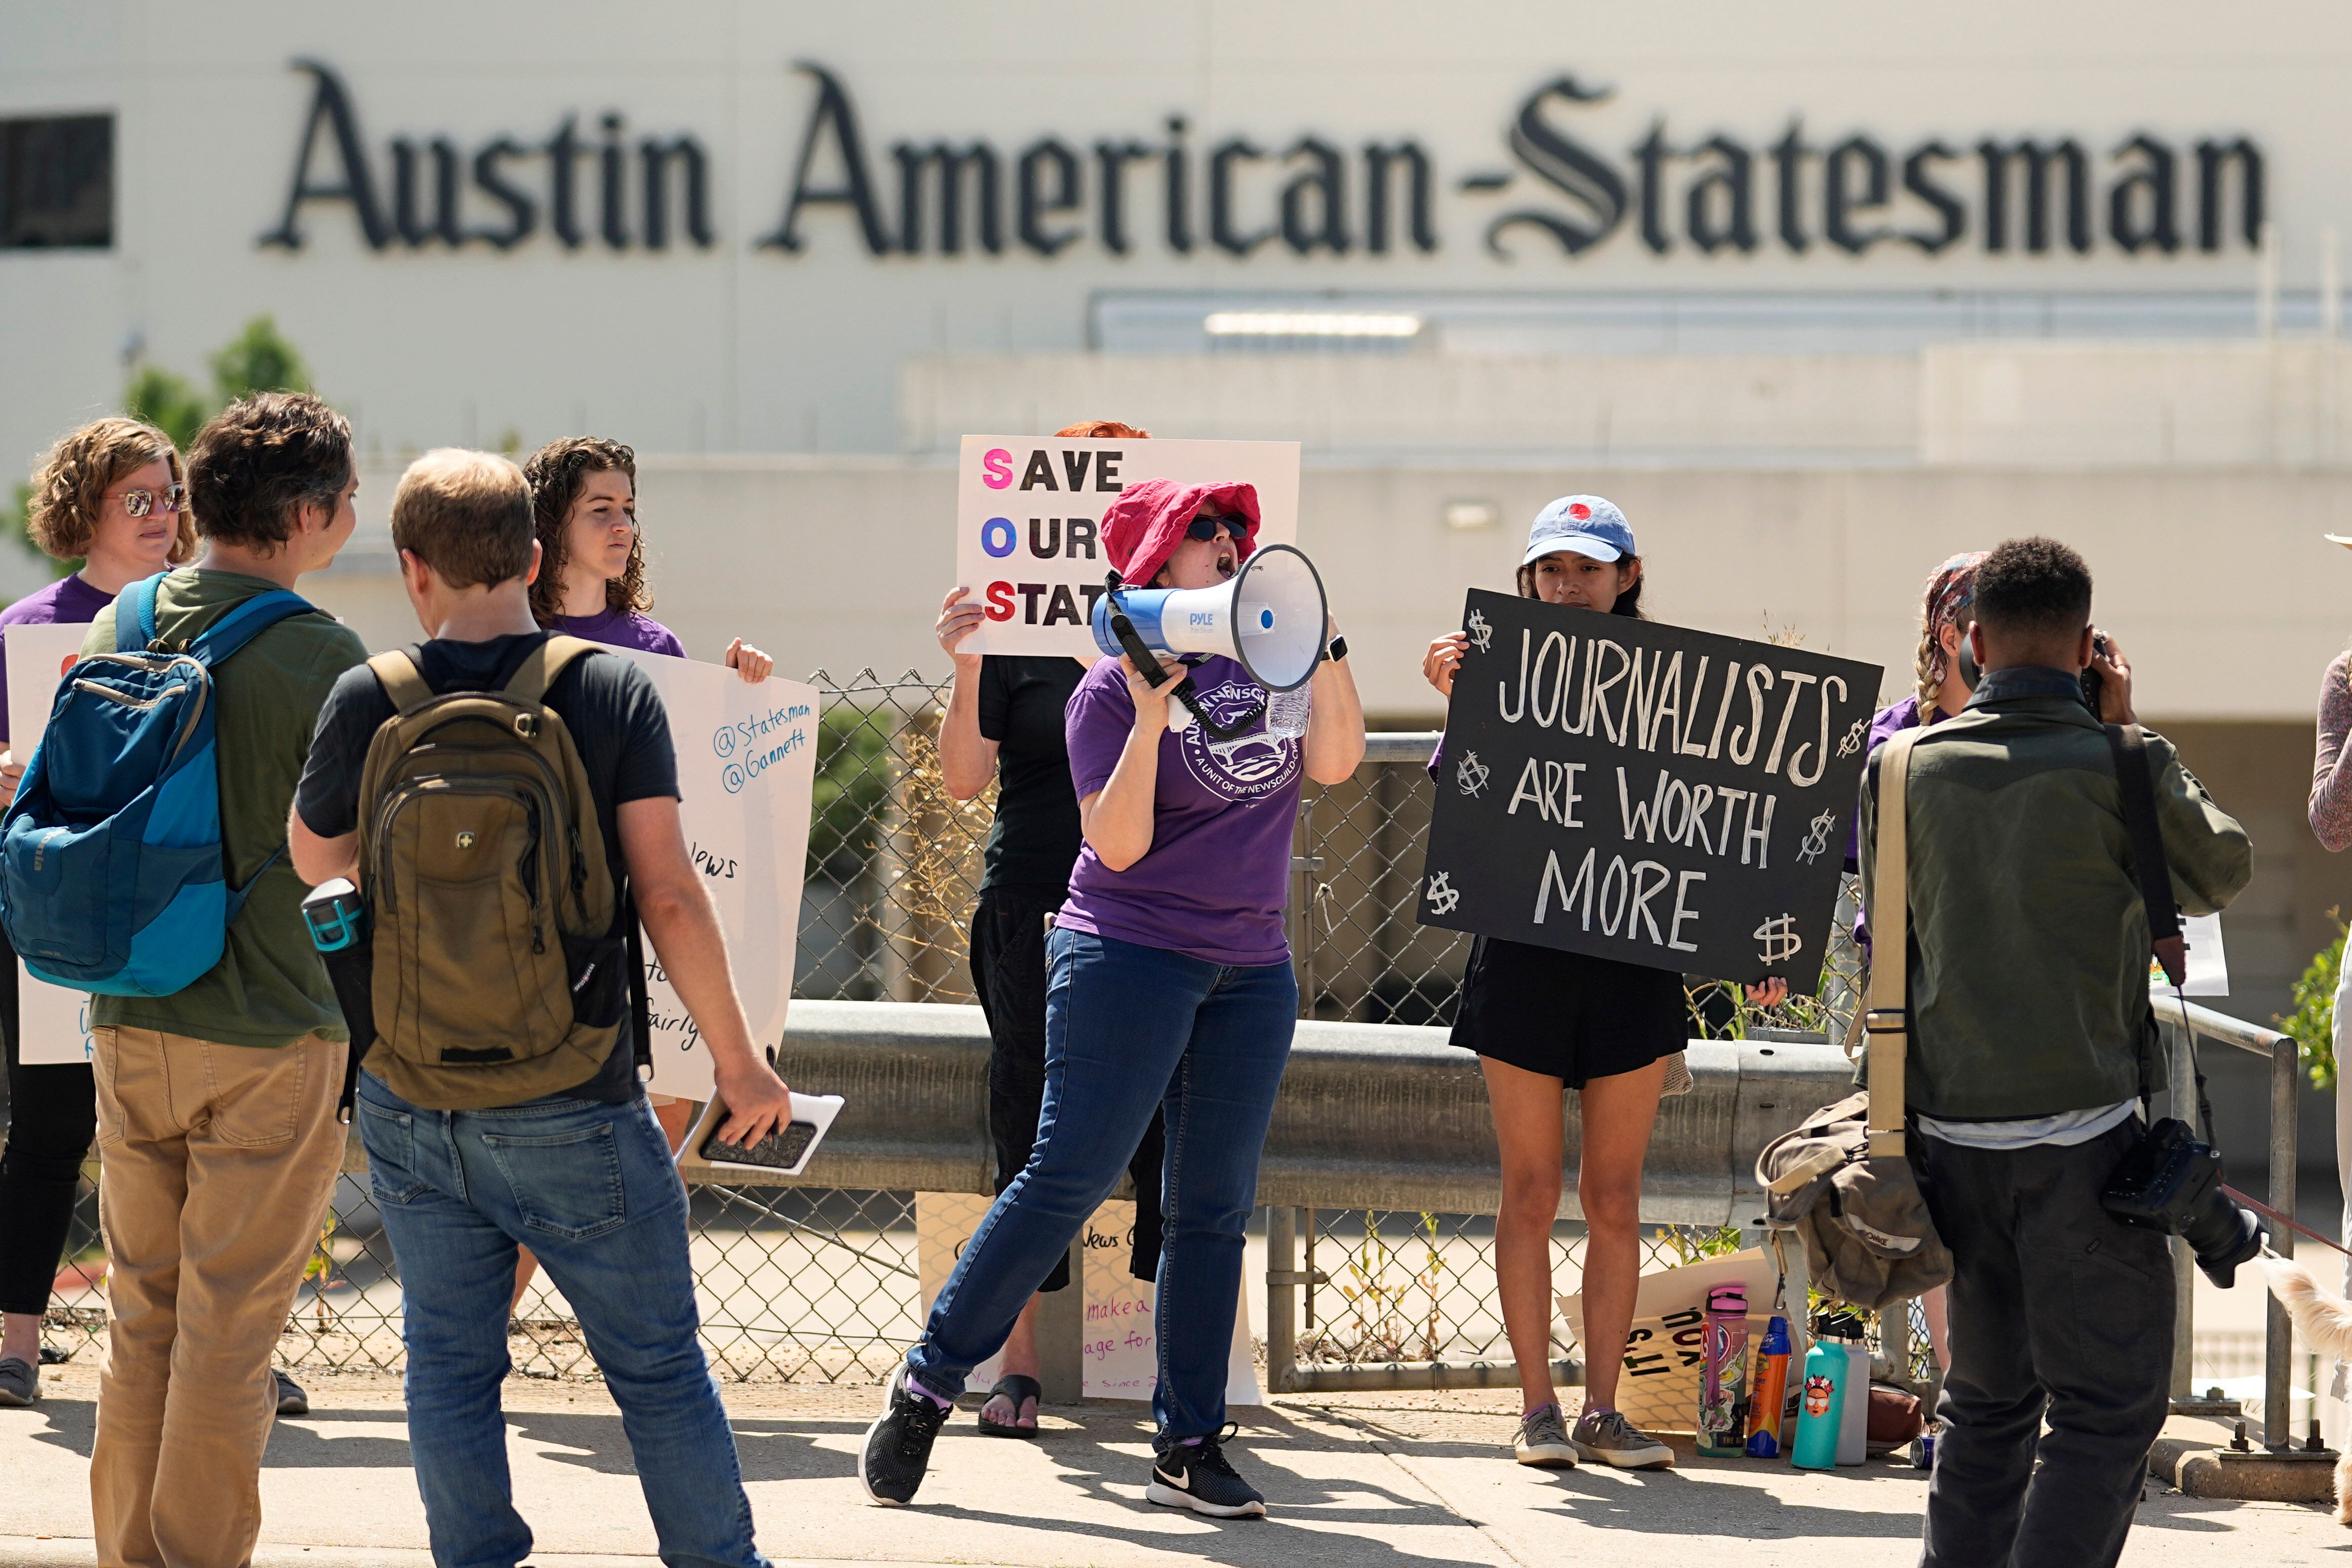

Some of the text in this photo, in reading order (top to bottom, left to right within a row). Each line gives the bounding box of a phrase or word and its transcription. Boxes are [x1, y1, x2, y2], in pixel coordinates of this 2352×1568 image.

[257, 60, 715, 254] Austin
[983, 448, 1123, 492] SAVE
[981, 517, 1097, 560] OUR
[985, 580, 1106, 626] STAT
[1190, 613, 1213, 625] PYLE
[1498, 628, 1847, 787] JOURNALISTS
[713, 704, 811, 758] @Statesman
[722, 728, 806, 794] @Gannett
[1196, 758, 1205, 766] A
[1202, 764, 1224, 784] UNIT
[1221, 781, 1235, 792] OF
[1234, 786, 1249, 794] THE
[1507, 757, 1777, 869] ARE WORTH
[1533, 847, 1707, 953] MORE
[1865, 1232, 1889, 1246] OMKE
[1088, 1296, 1151, 1321] make a
[1085, 1330, 1152, 1361] age for
[1102, 1378, 1140, 1387] since
